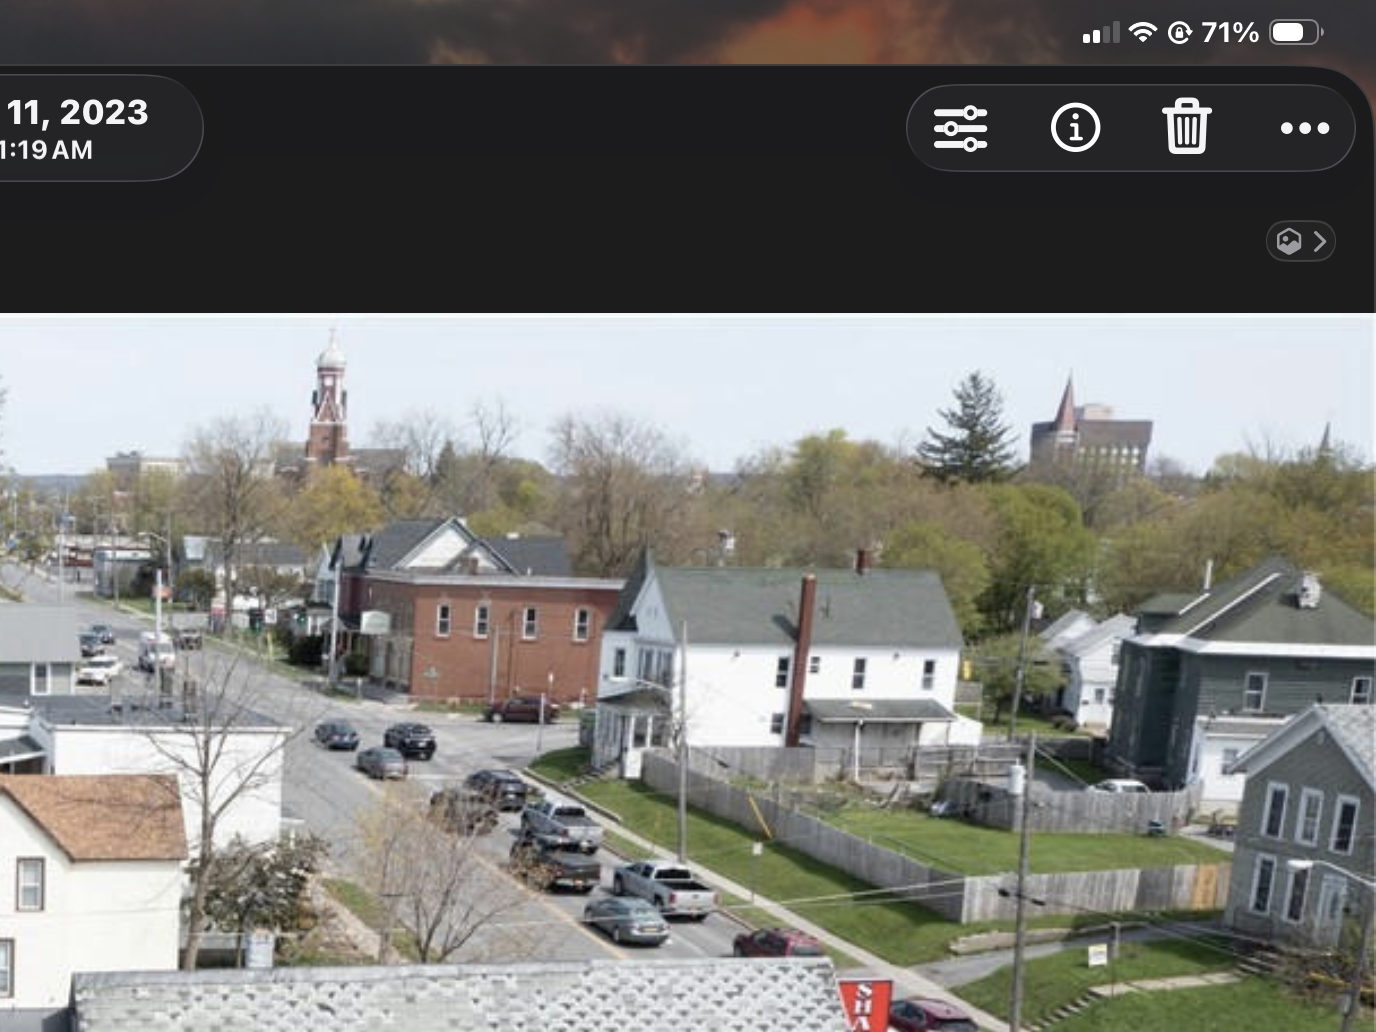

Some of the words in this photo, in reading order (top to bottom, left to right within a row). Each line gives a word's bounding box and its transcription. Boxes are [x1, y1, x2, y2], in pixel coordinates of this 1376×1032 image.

[1201, 21, 1260, 43] 71%
[7, 99, 50, 132] 11,
[60, 98, 148, 126] 2023
[51, 139, 92, 160] AM
